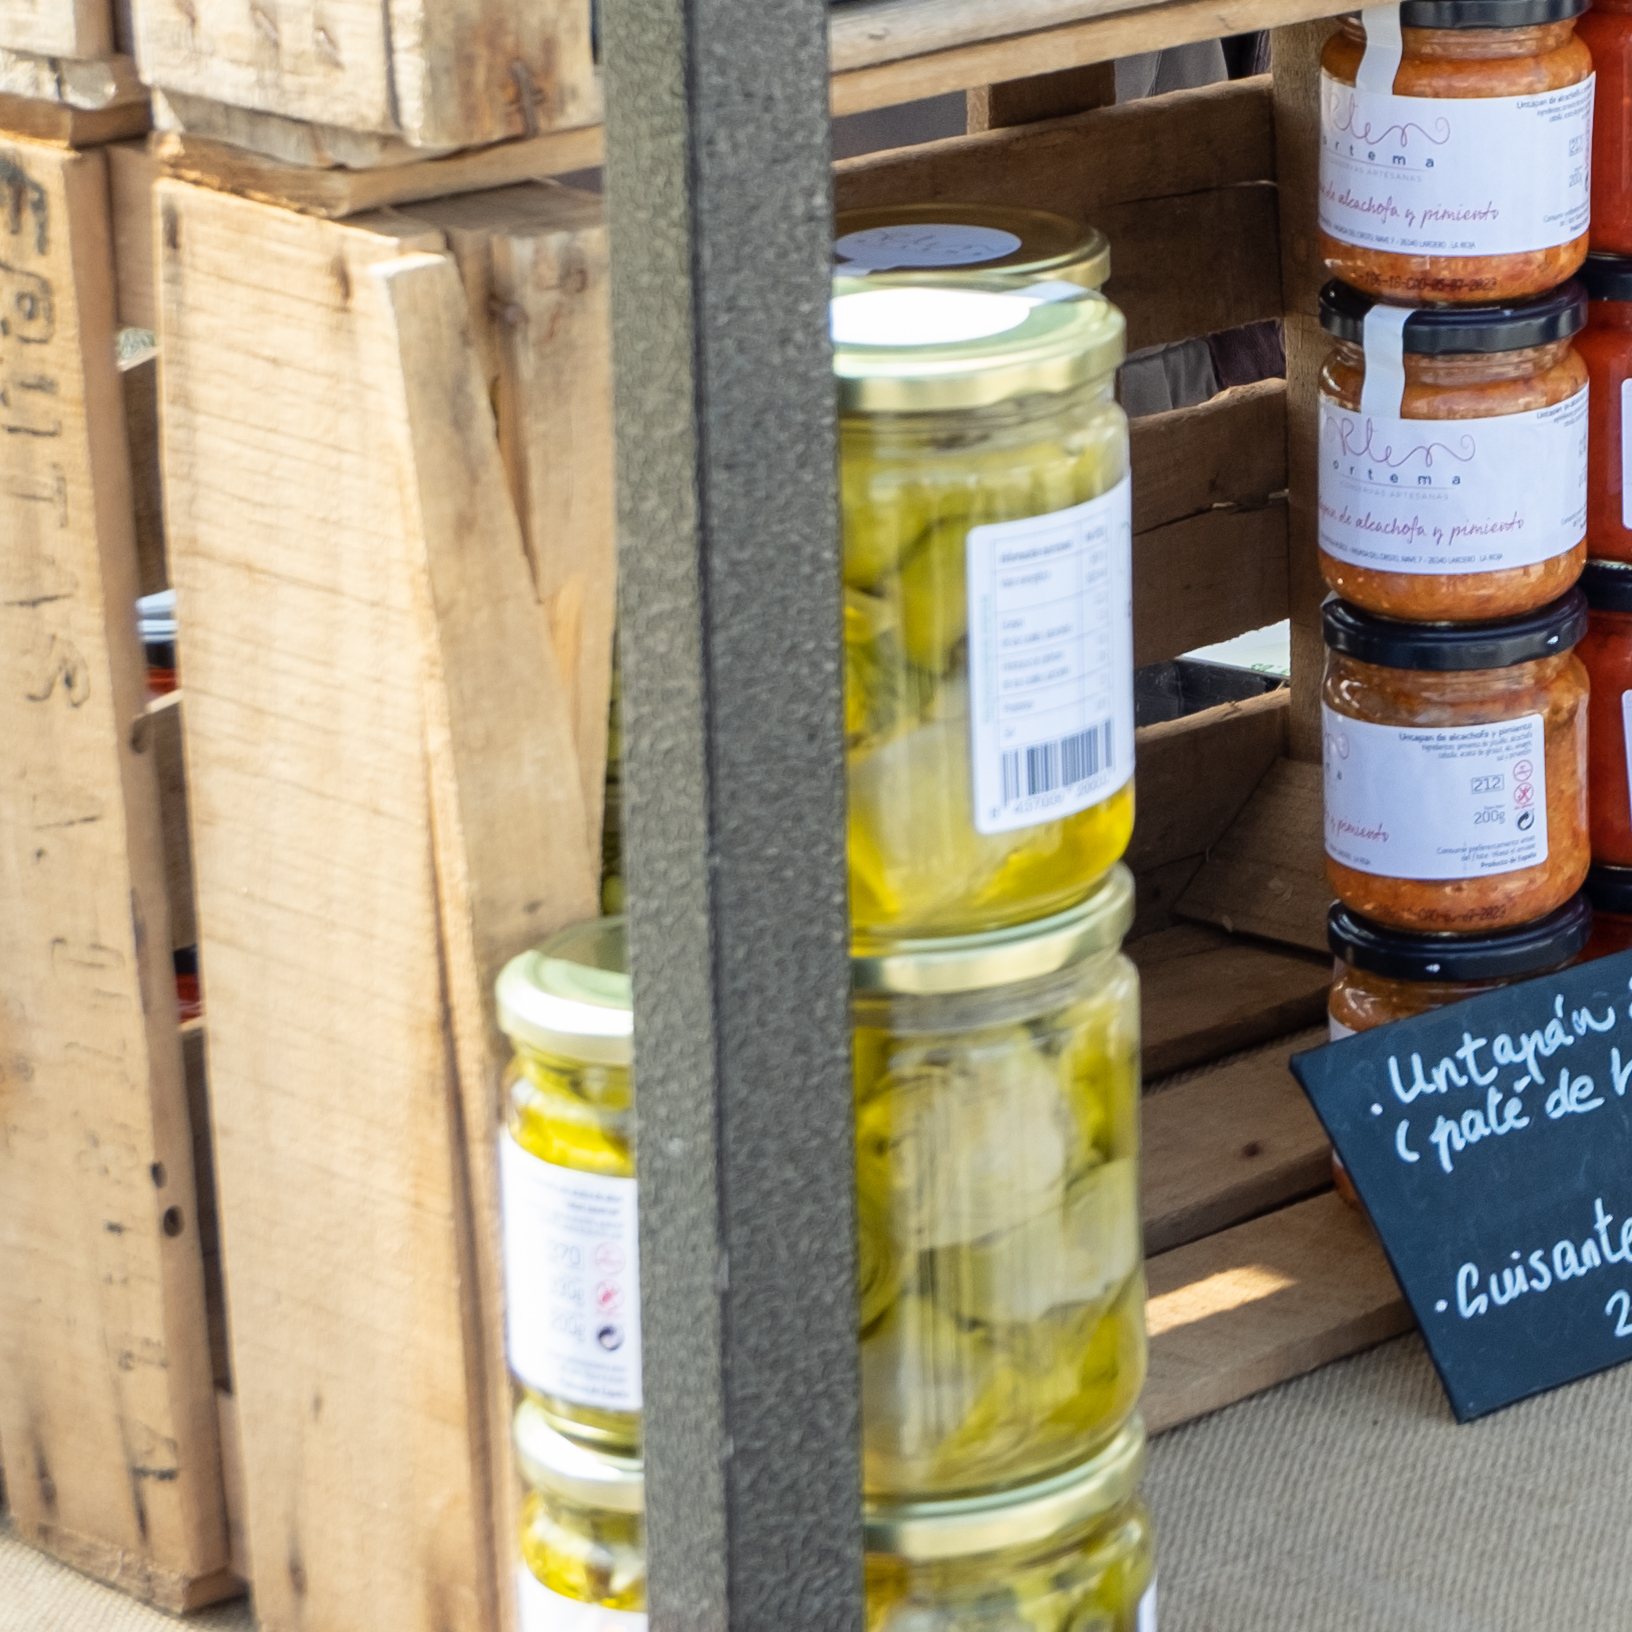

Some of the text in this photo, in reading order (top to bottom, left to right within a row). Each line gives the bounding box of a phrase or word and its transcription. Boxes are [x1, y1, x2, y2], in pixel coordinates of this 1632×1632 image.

[1338, 189, 1400, 223] alcachofa
[1332, 459, 1461, 486] ortema
[1356, 511, 1427, 545] alcachofa
[1449, 511, 1525, 546] pimiento
[1473, 777, 1501, 792] 212
[1474, 810, 1506, 825] 200g
[1546, 1068, 1604, 1119] de
